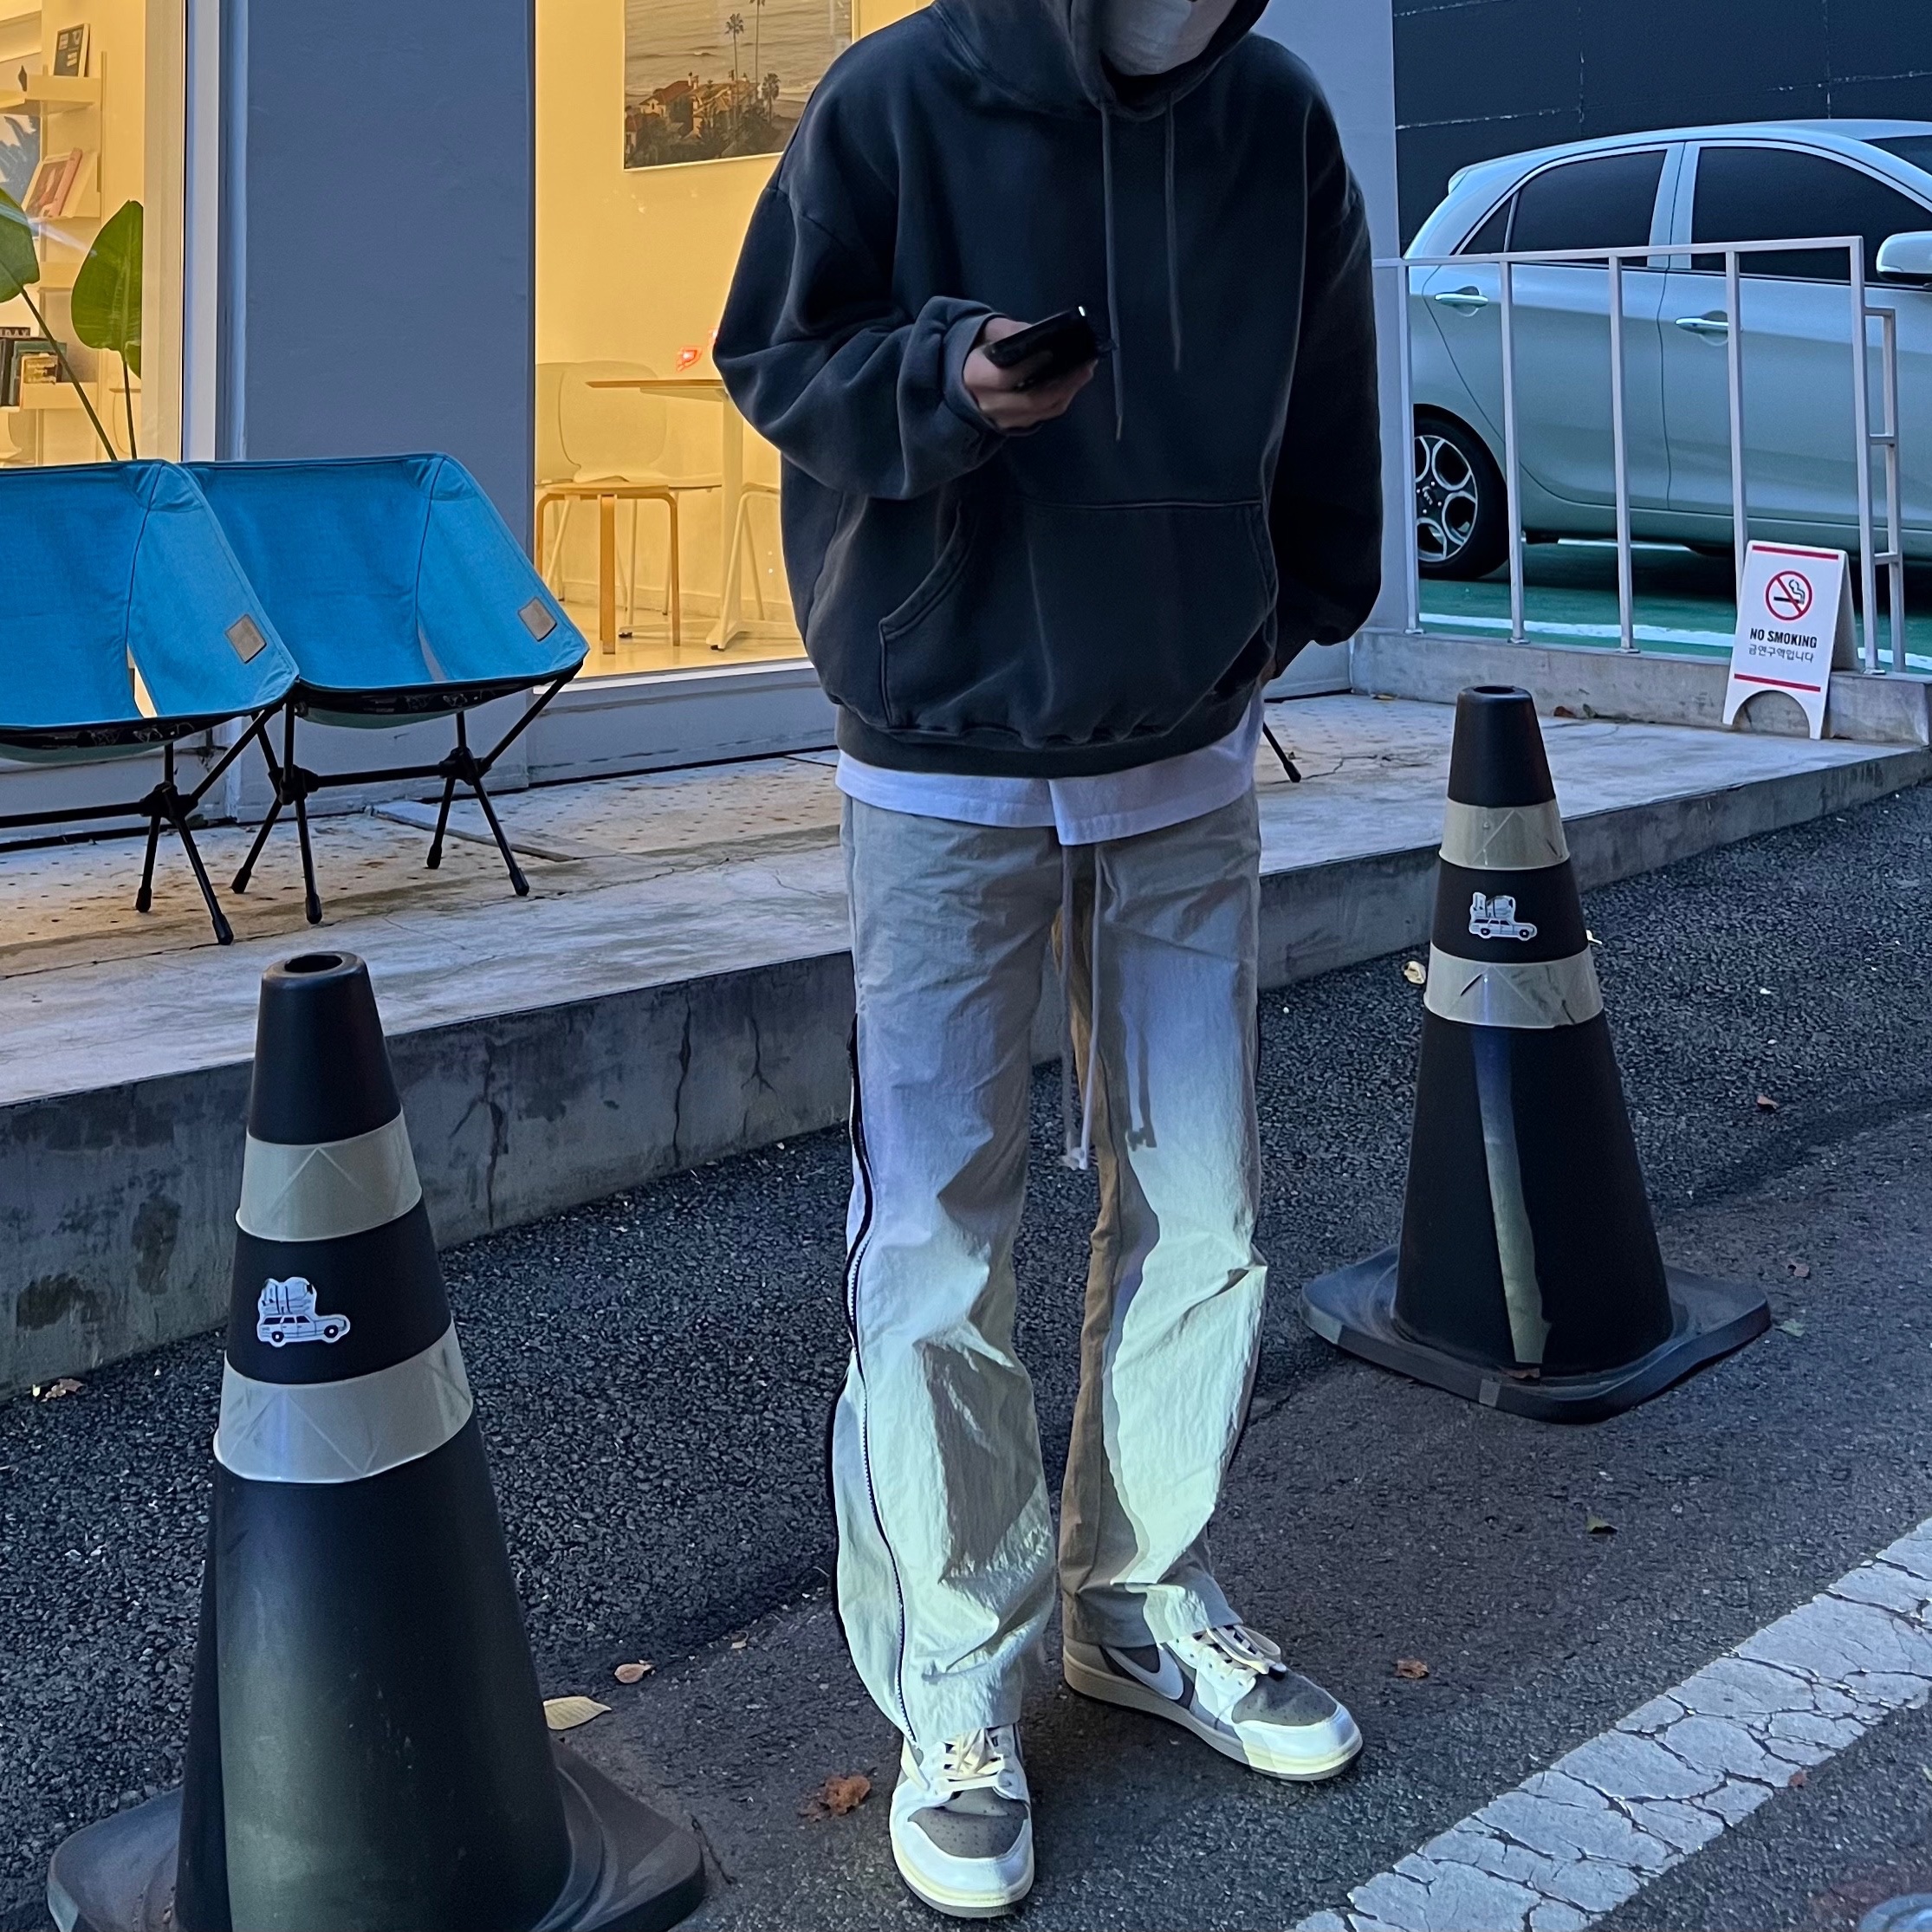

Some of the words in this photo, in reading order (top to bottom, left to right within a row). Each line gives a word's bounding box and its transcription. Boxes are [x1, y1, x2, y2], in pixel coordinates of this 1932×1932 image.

[1750, 628, 1765, 640] NO
[1767, 631, 1817, 648] SMOKING
[1748, 644, 1813, 663] 금연구역입니다
